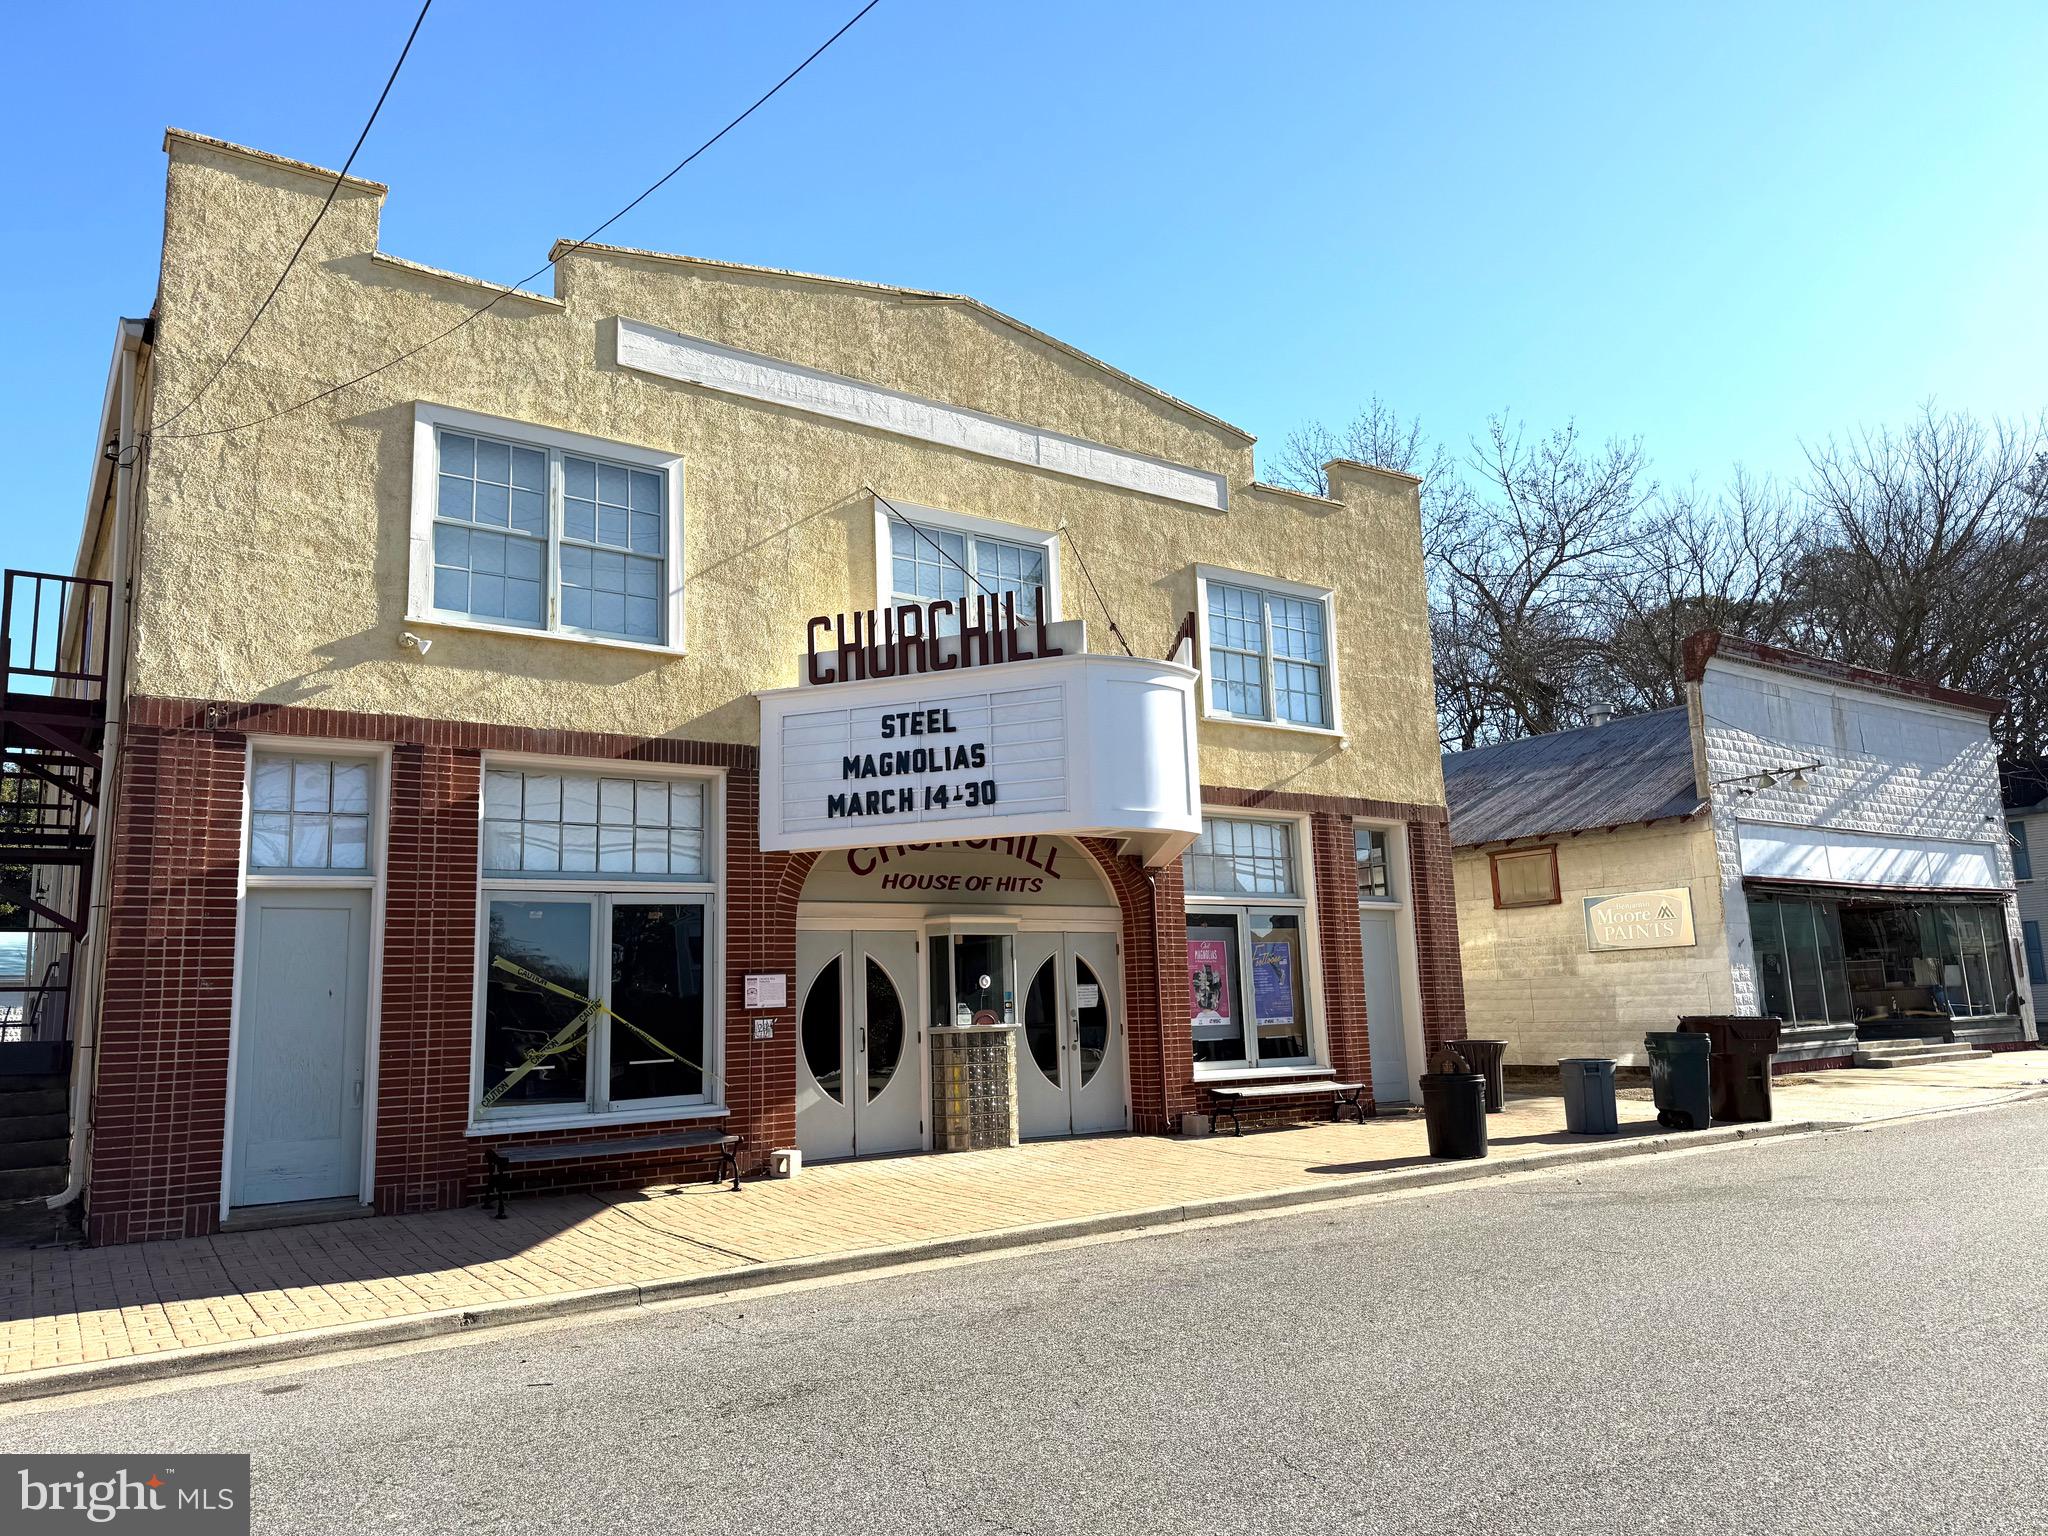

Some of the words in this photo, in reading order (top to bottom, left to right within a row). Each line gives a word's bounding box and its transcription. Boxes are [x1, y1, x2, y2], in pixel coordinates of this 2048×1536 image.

[807, 586, 1064, 686] CHURCHILL
[881, 708, 957, 739] STEEL
[842, 743, 986, 780] MAGNOLIAS
[827, 787, 914, 819] MARCH
[924, 780, 997, 810] 14-30
[847, 836, 1061, 879] CHILL
[881, 873, 962, 891] HOUSE
[964, 875, 994, 891] OF
[995, 876, 1044, 893] HITS
[1597, 908, 1651, 925] Moore
[1604, 921, 1674, 941] PAINTS
[517, 968, 547, 986] CAUTION
[579, 998, 602, 1023] CAUTIO
[530, 1039, 559, 1065] CAION
[481, 1080, 509, 1108] CAUTION
